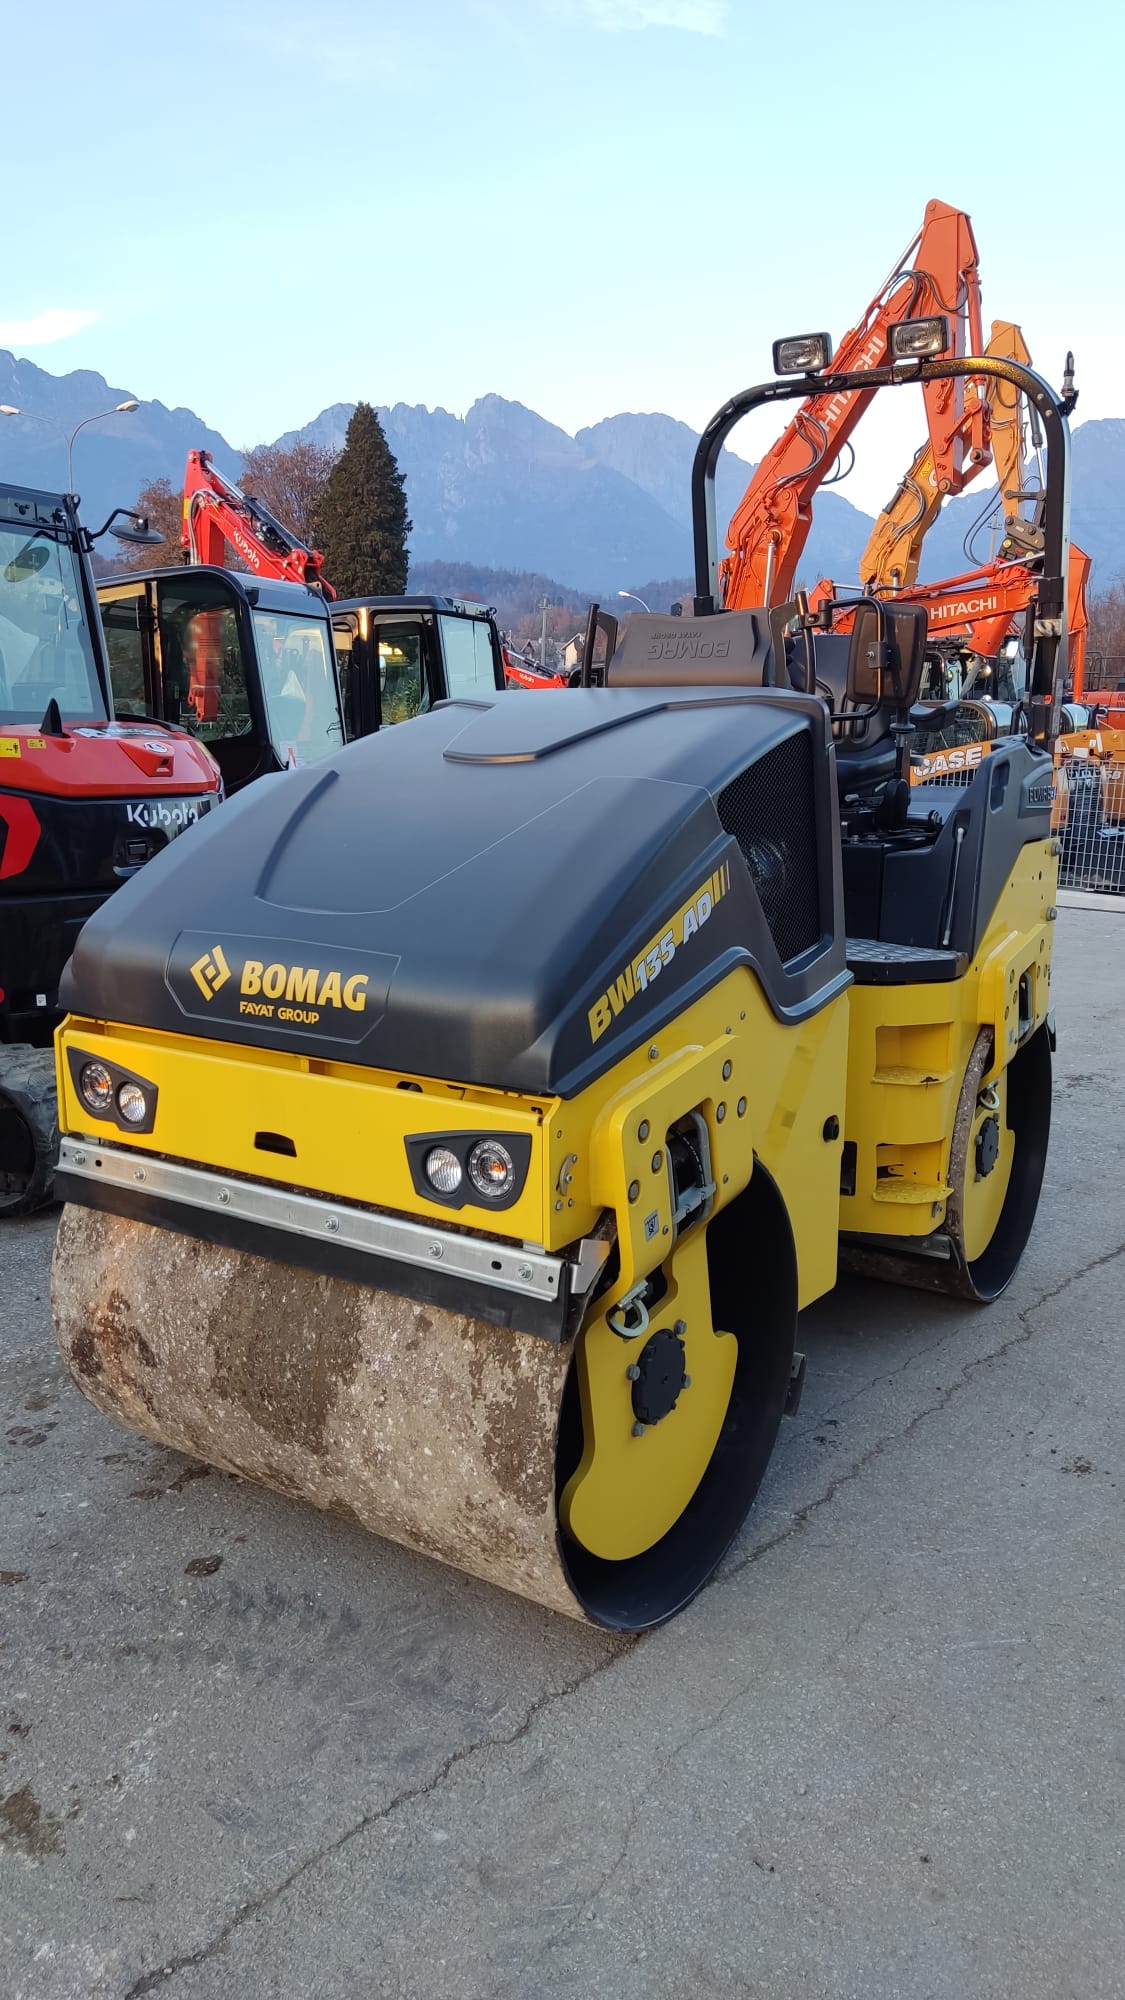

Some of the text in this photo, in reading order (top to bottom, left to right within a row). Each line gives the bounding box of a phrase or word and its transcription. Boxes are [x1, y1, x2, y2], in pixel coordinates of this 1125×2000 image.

[825, 336, 885, 432] HITCHI
[233, 527, 260, 568] Kubota
[930, 596, 997, 620] HITACHI
[648, 639, 731, 659] BOMAG
[913, 746, 983, 777] CASE
[127, 803, 198, 827] Kubota
[683, 892, 713, 944] AD
[240, 960, 369, 1011] BOMAG
[240, 1001, 320, 1025] FAYAT GROUP
